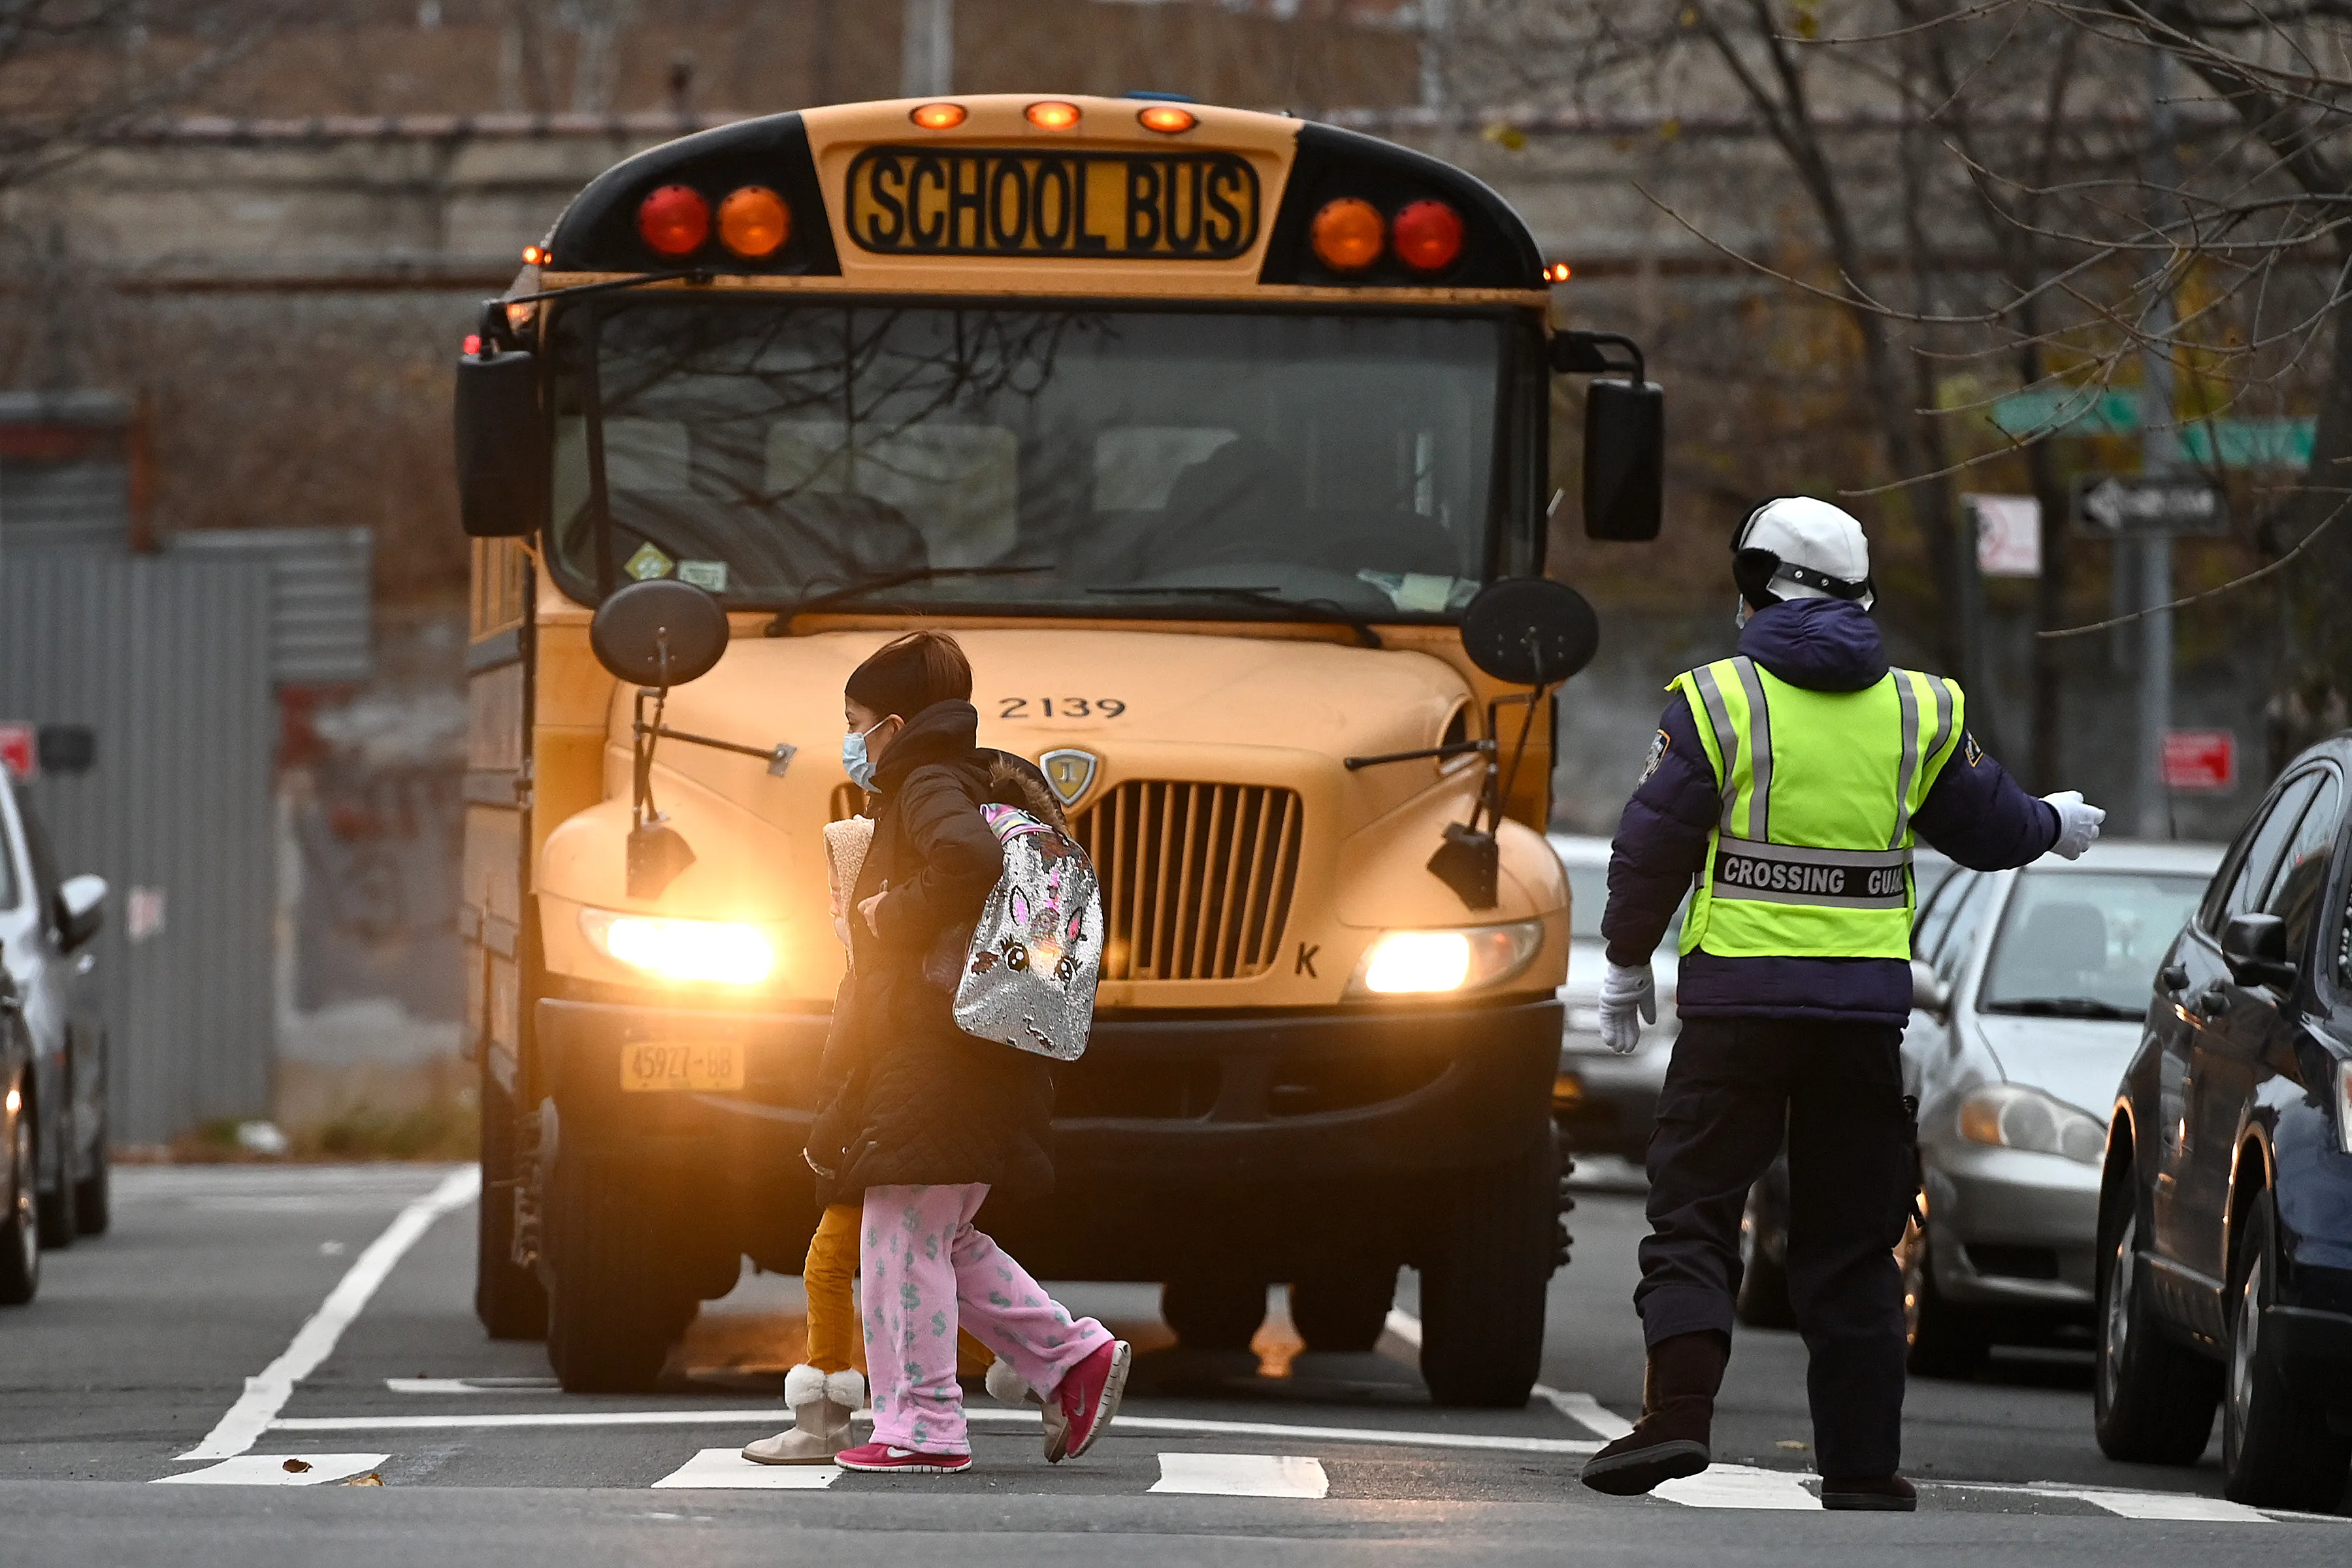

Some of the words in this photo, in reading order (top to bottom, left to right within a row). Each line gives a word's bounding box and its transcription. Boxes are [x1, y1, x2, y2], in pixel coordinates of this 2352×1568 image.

[868, 155, 1107, 251] SCHOOL
[1126, 160, 1243, 253] BUS
[998, 696, 1126, 719] 2139
[1723, 857, 1846, 894] CROSSING
[1294, 940, 1320, 979] K
